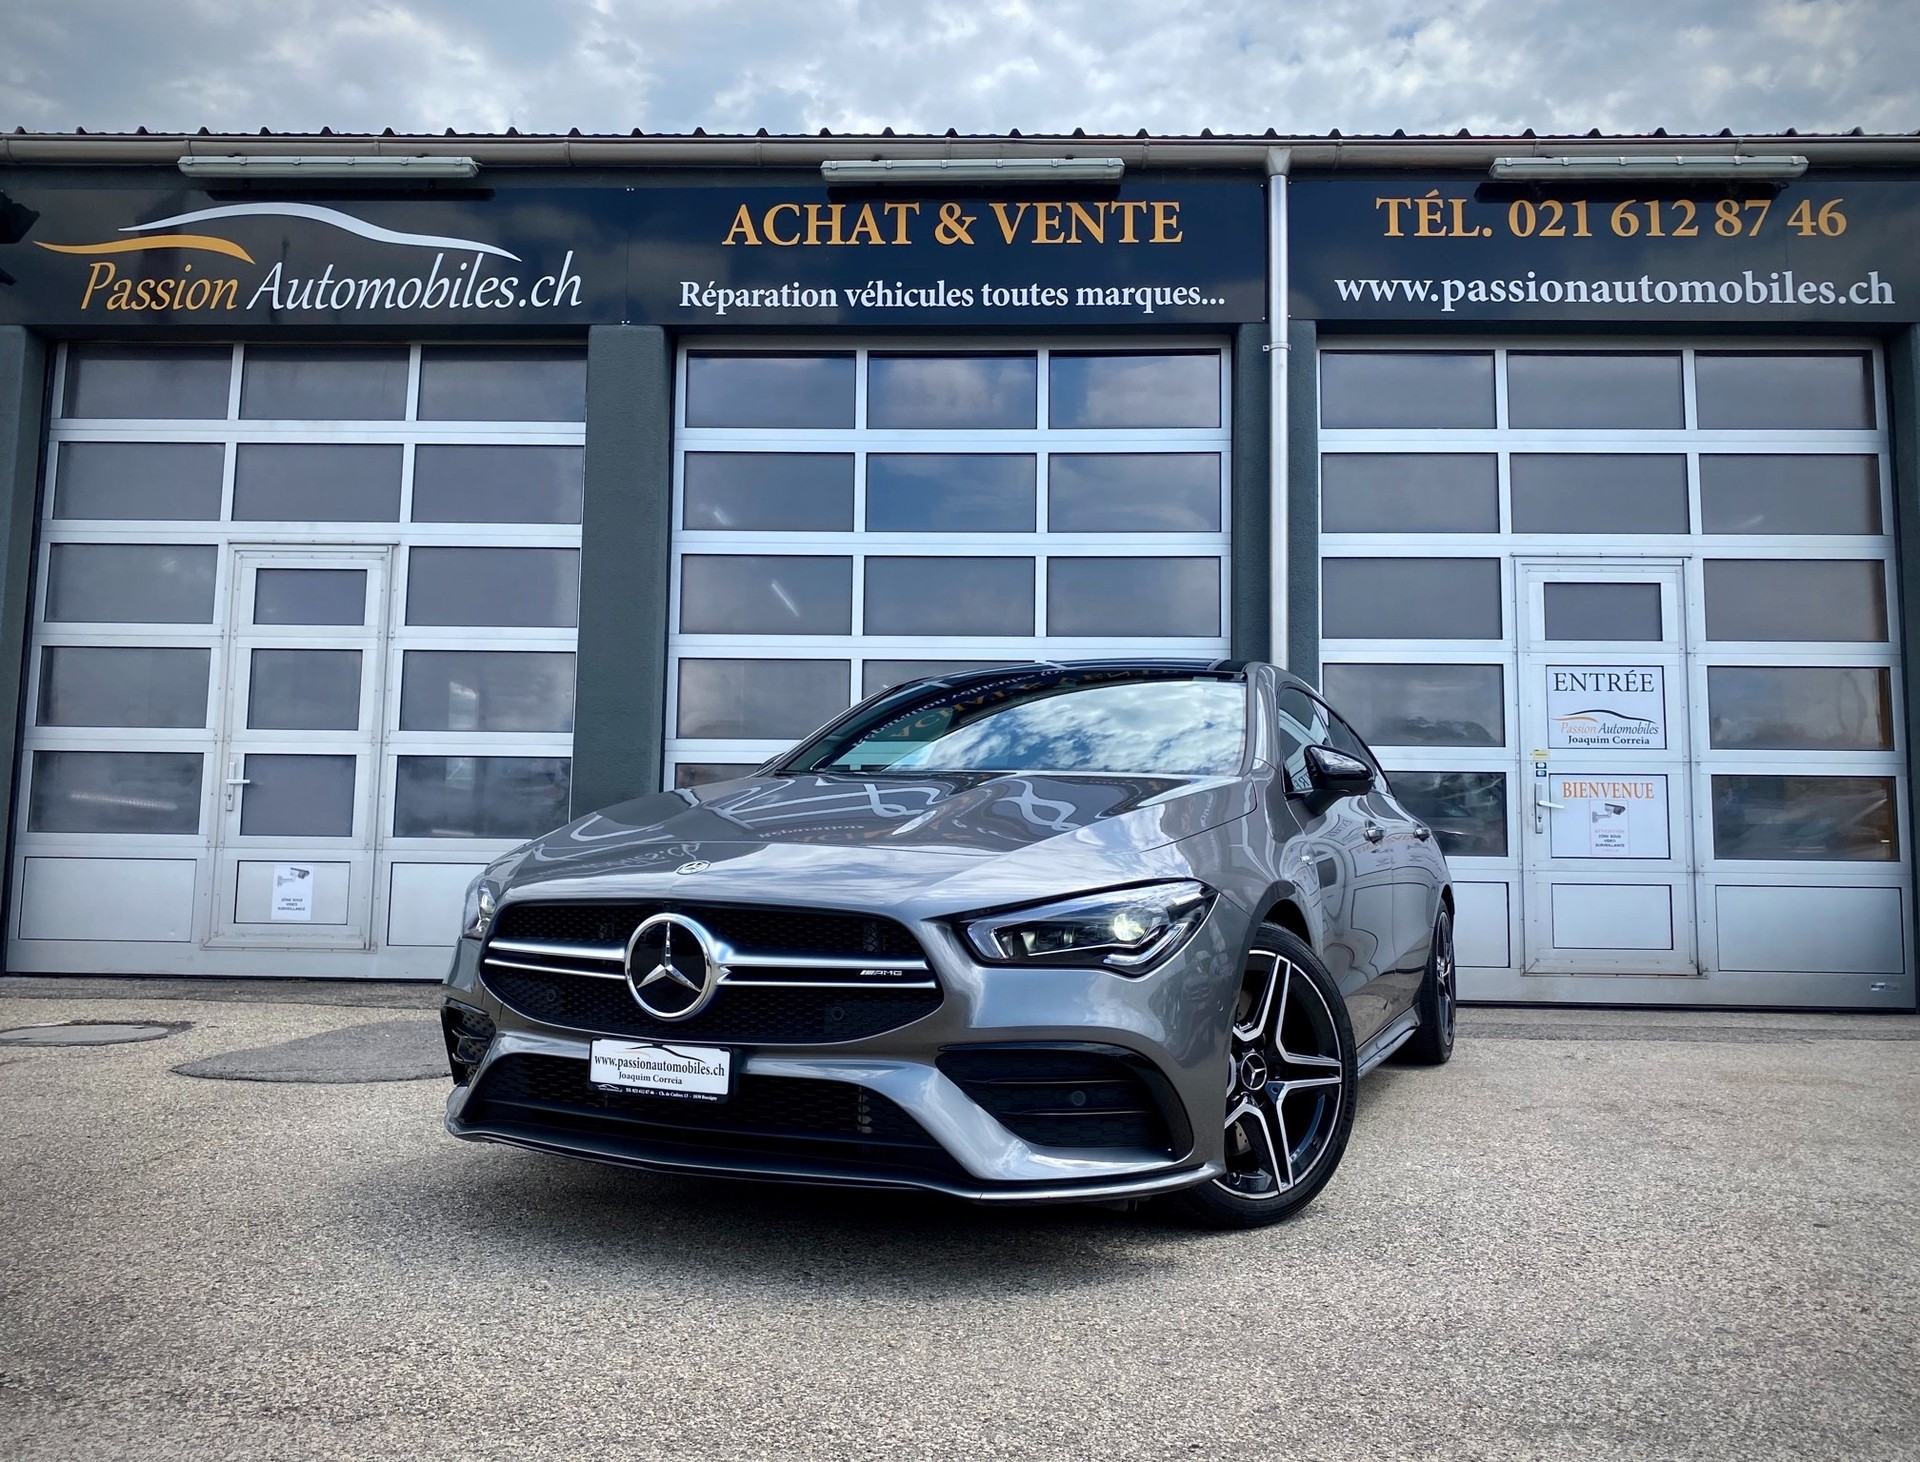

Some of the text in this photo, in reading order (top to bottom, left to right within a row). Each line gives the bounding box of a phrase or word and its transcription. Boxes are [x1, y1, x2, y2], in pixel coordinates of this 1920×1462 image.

[721, 201, 1183, 246] ACHAT & VENTE
[1376, 190, 1848, 238] TÉL. 021 612 87 46
[81, 250, 583, 311] Passion Automobiles.ch
[1334, 271, 1895, 311] www.passionautomobiles.ch
[680, 280, 1225, 315] Réparation véhicules toutes marques...
[1553, 670, 1655, 693] ENTRÉE
[1560, 721, 1659, 735] Passion Automobiles
[1568, 735, 1650, 745] Joaquim Correia
[1562, 781, 1654, 799] BIENVENUE
[872, 969, 903, 977] AMG
[594, 1055, 725, 1076] www.passionautomobiles.ch
[618, 1071, 683, 1085] Joaquim Correia
